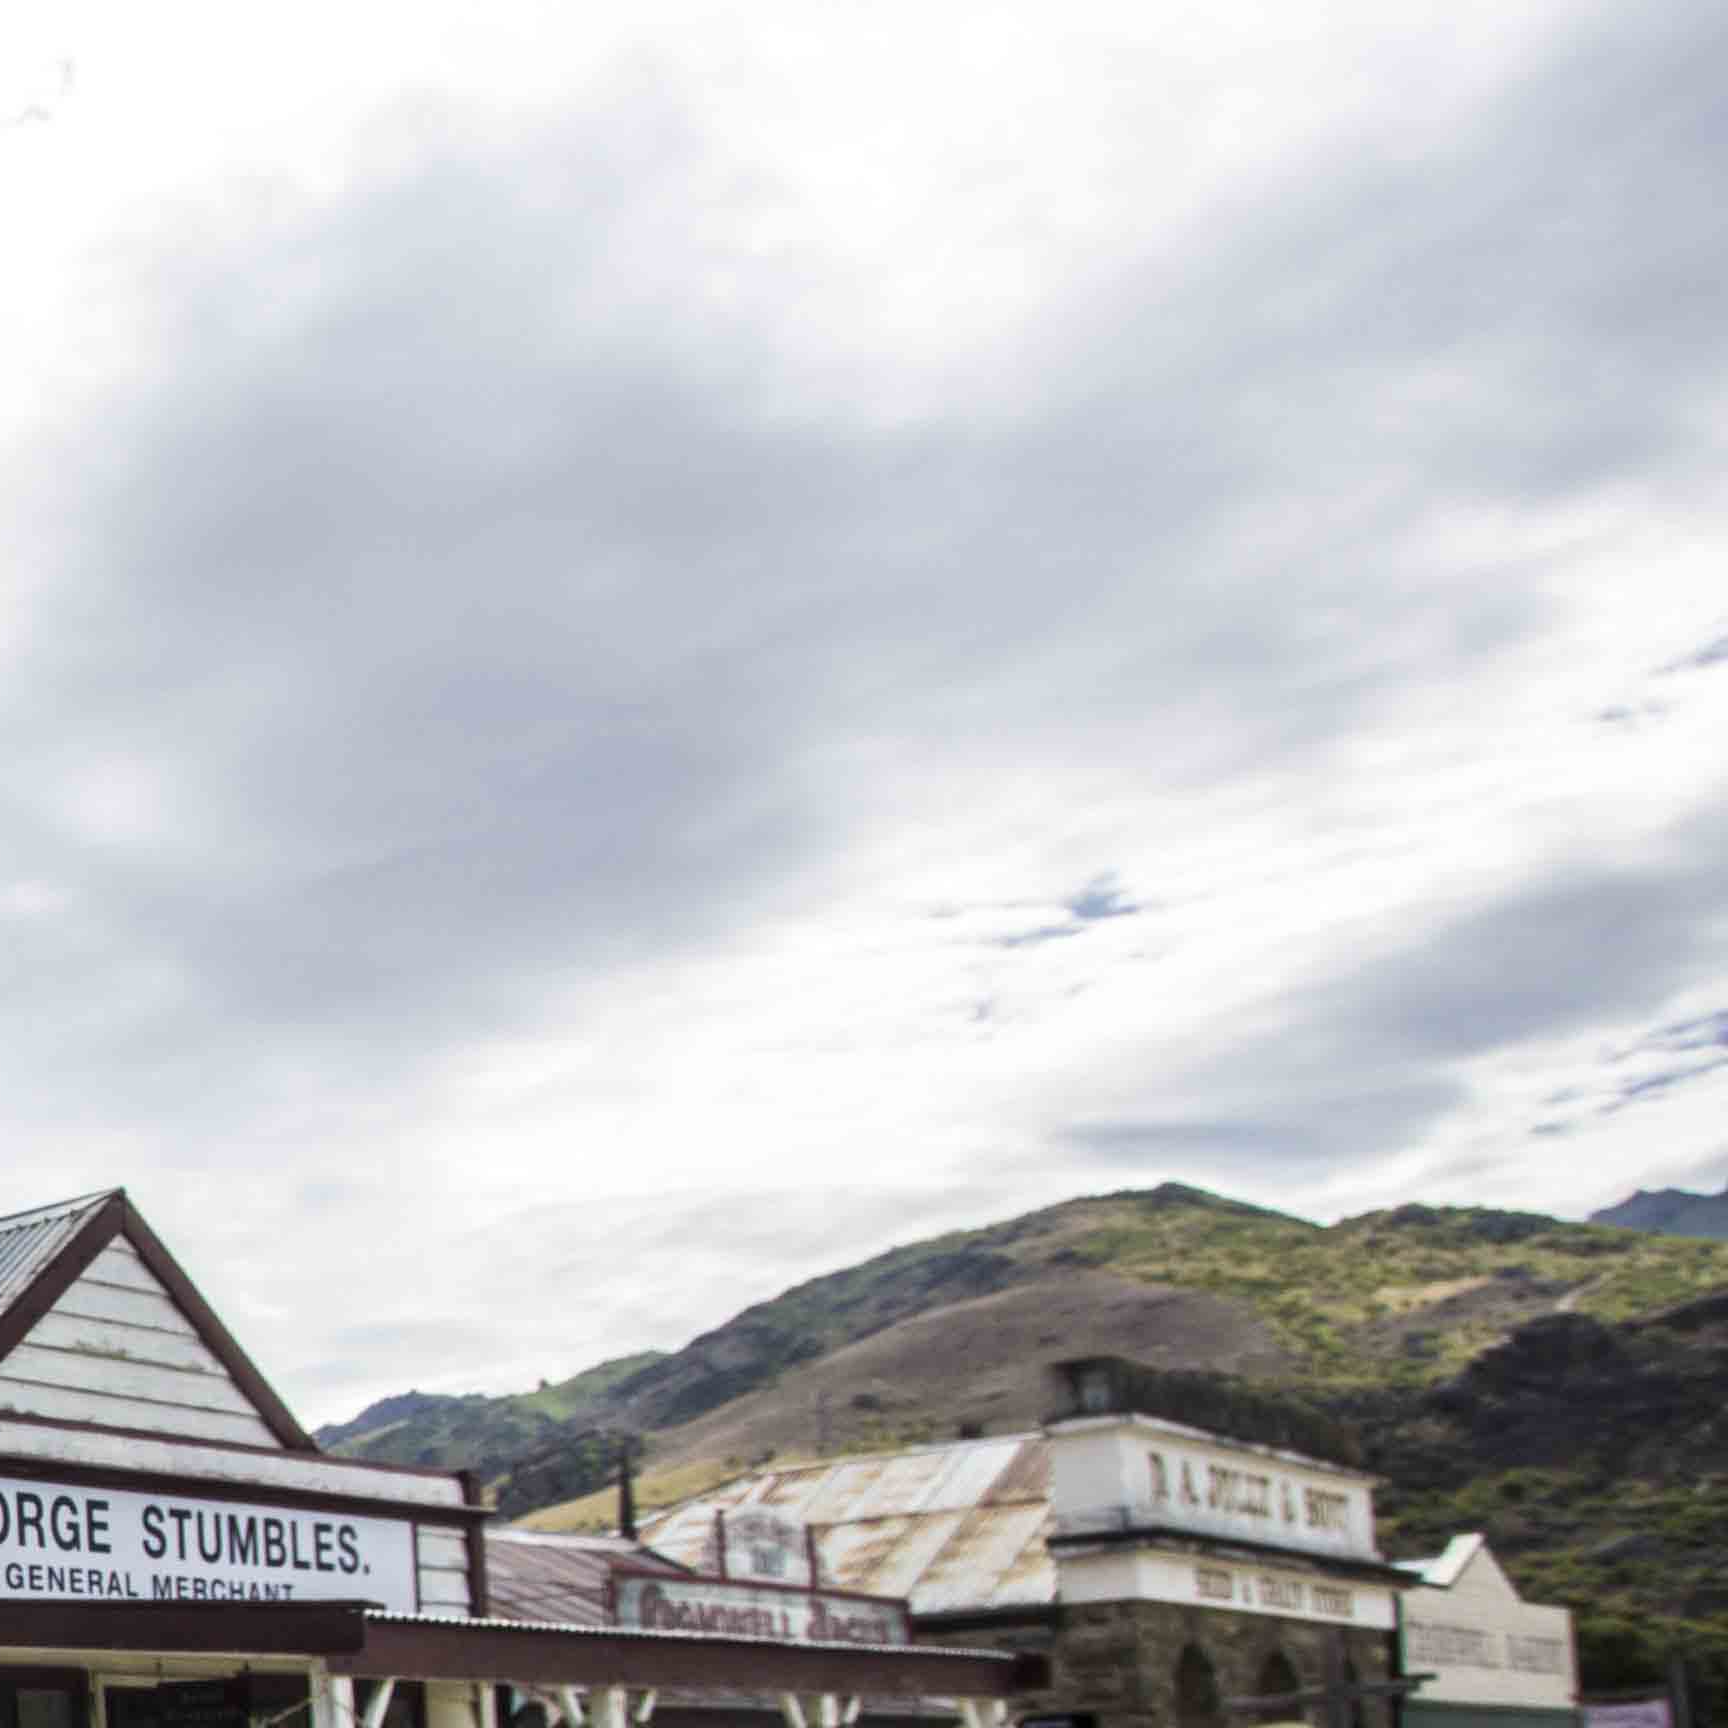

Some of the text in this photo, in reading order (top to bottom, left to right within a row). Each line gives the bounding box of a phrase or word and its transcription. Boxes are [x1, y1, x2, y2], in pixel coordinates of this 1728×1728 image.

[141, 1503, 372, 1575] STUMBLES.
[4, 1562, 296, 1600] GENERAL MERCHANT
